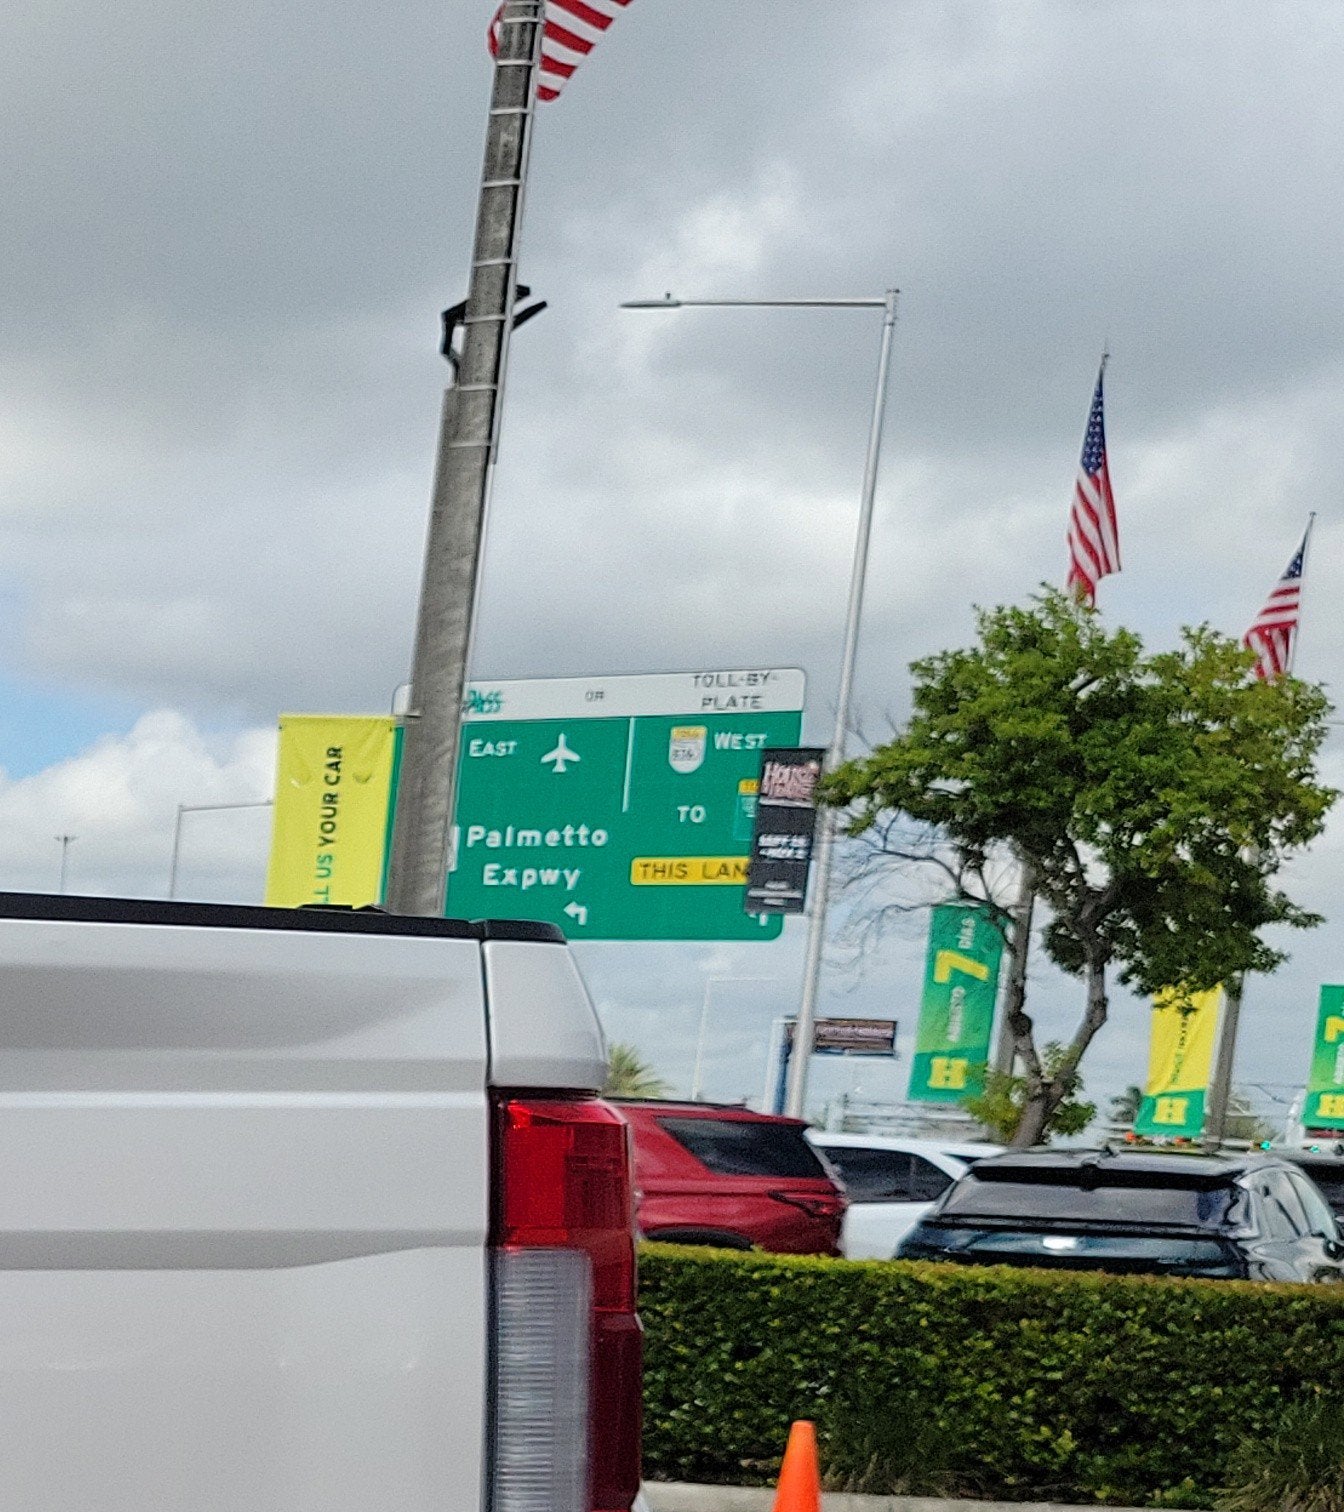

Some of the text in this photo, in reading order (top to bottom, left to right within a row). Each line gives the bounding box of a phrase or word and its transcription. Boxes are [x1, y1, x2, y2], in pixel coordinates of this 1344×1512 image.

[701, 695, 763, 710] PLATE
[469, 738, 517, 757] EAST
[714, 731, 768, 750] WEST
[325, 747, 344, 787] CAR
[319, 793, 340, 847] YOUR
[677, 805, 706, 823] TO
[466, 824, 609, 848] Palmetto
[315, 854, 334, 879] US
[482, 863, 581, 890] Expwy
[640, 860, 750, 879] THIS LAN
[933, 950, 991, 984] 7
